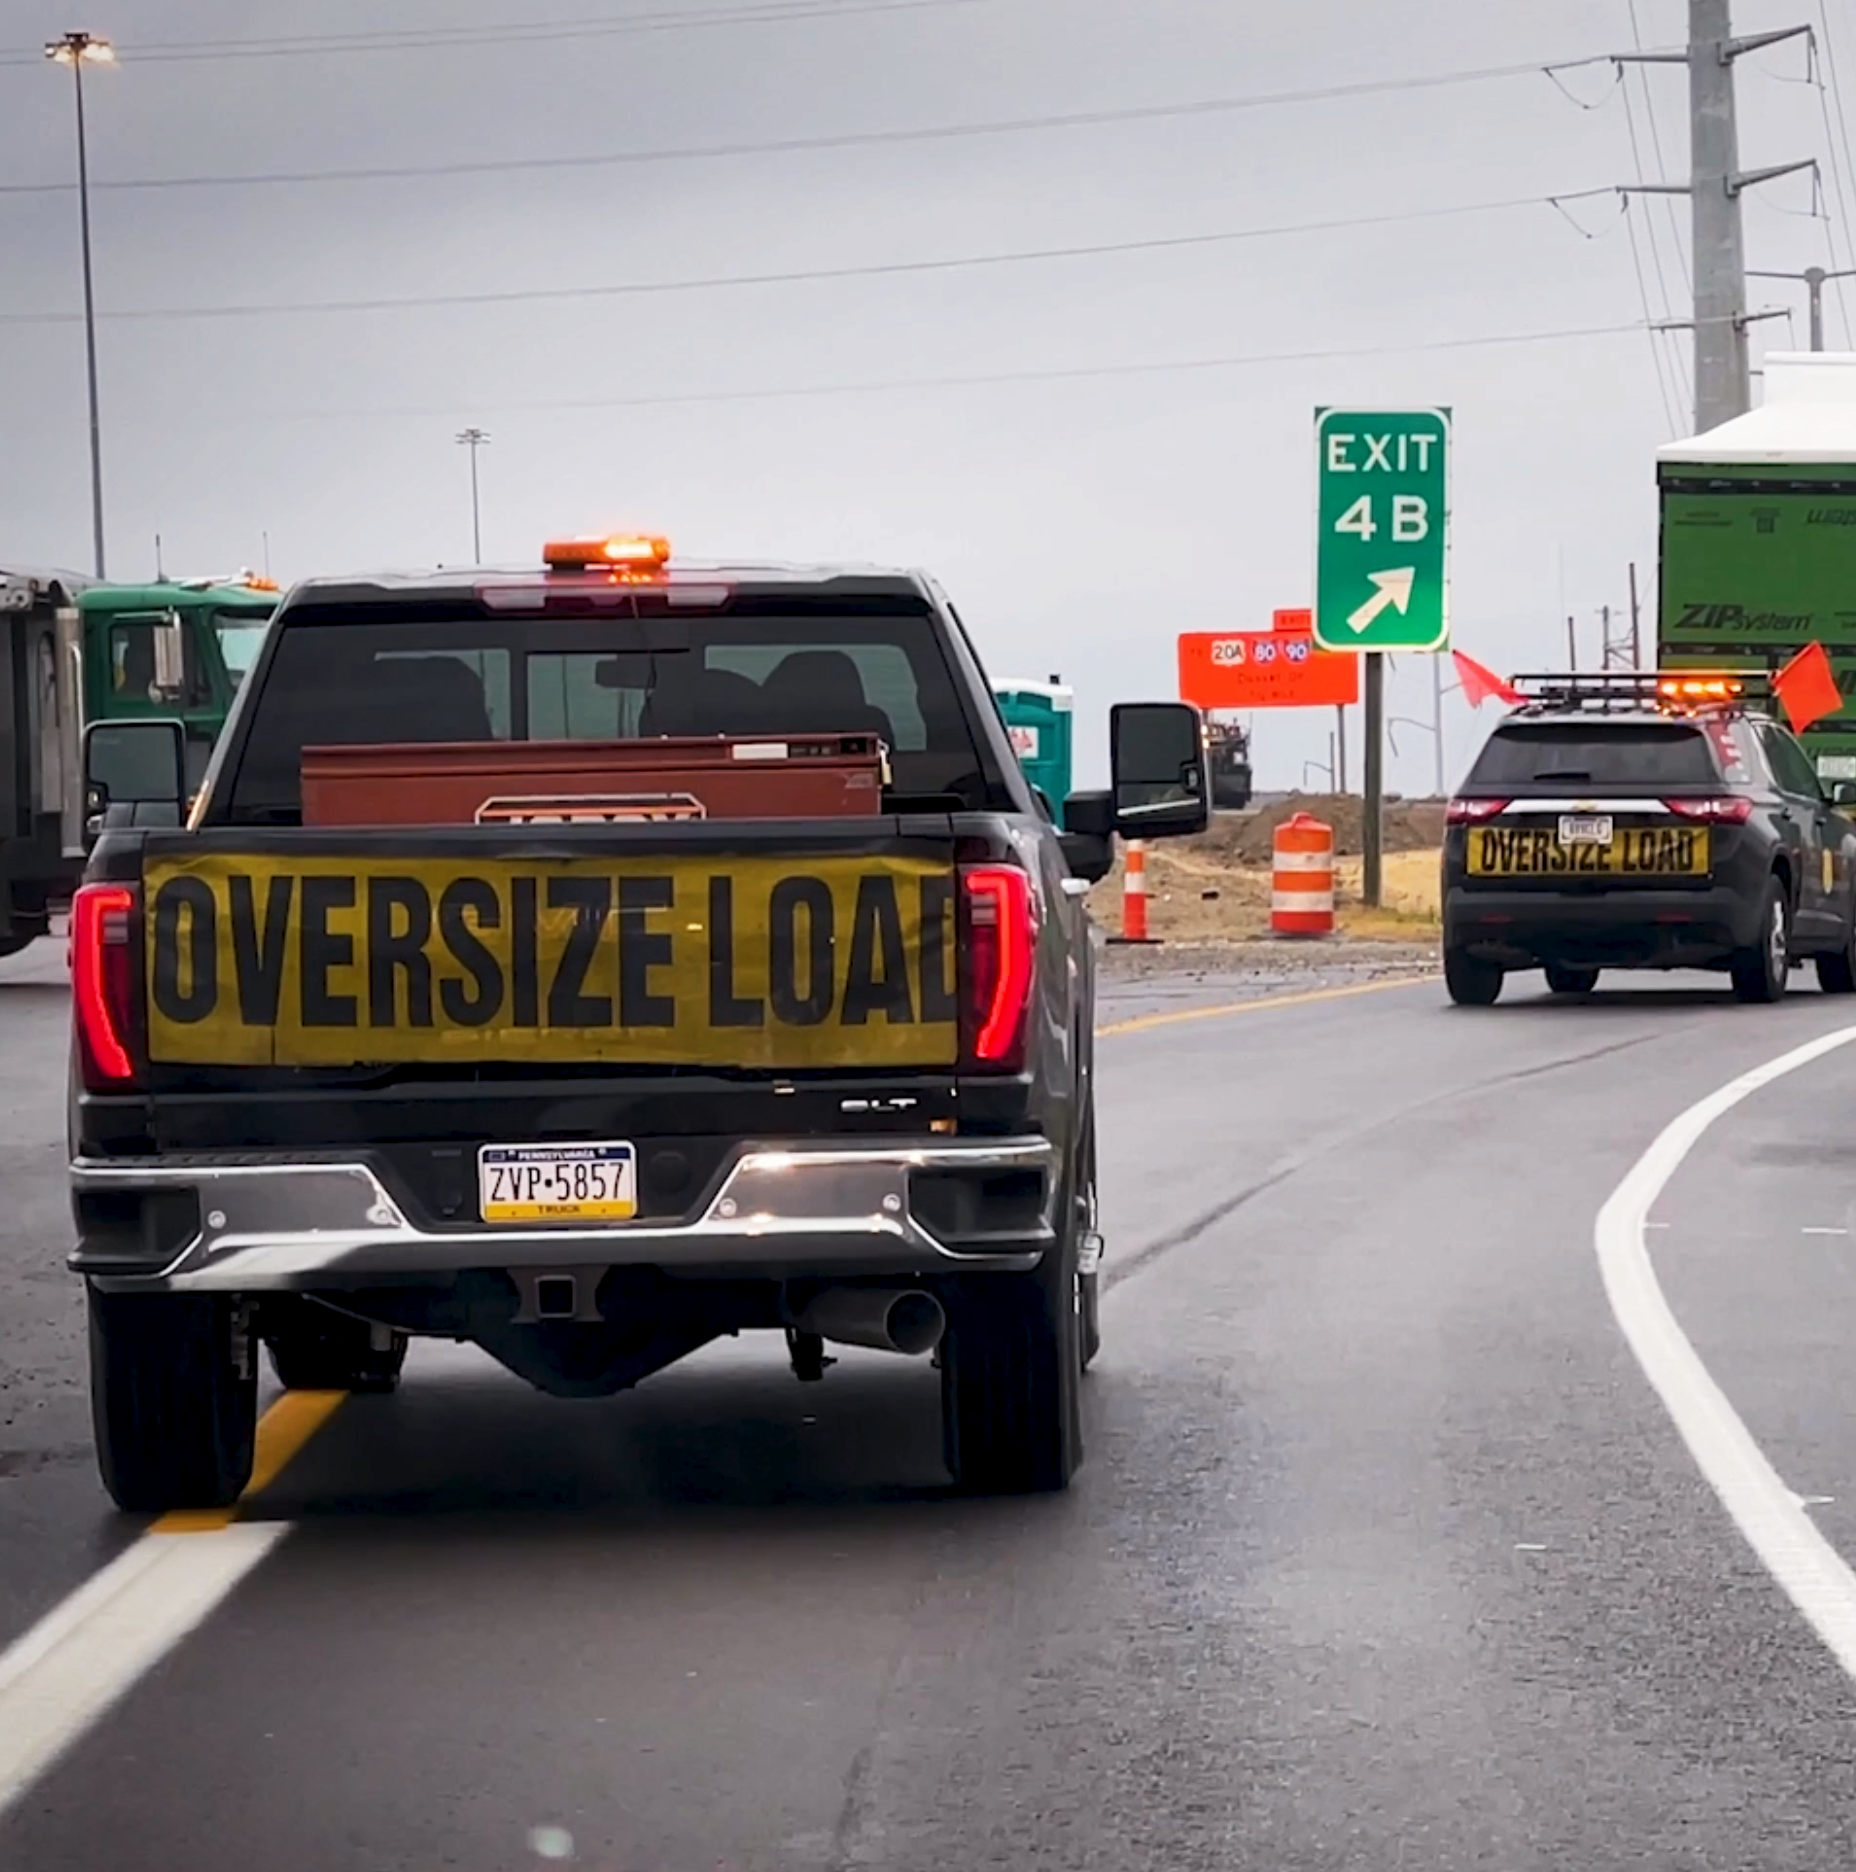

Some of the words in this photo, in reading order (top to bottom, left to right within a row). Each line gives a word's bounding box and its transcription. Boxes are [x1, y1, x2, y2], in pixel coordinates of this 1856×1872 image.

[1327, 433, 1438, 472] EXIT
[1215, 644, 1243, 660] 20A
[1255, 644, 1276, 660] 80
[1286, 643, 1306, 660] 90
[1481, 829, 1612, 872] OVERSIZE
[1623, 830, 1693, 872] LOAD
[151, 874, 675, 1028] OVERSIZE
[537, 1204, 581, 1215] TRUCK
